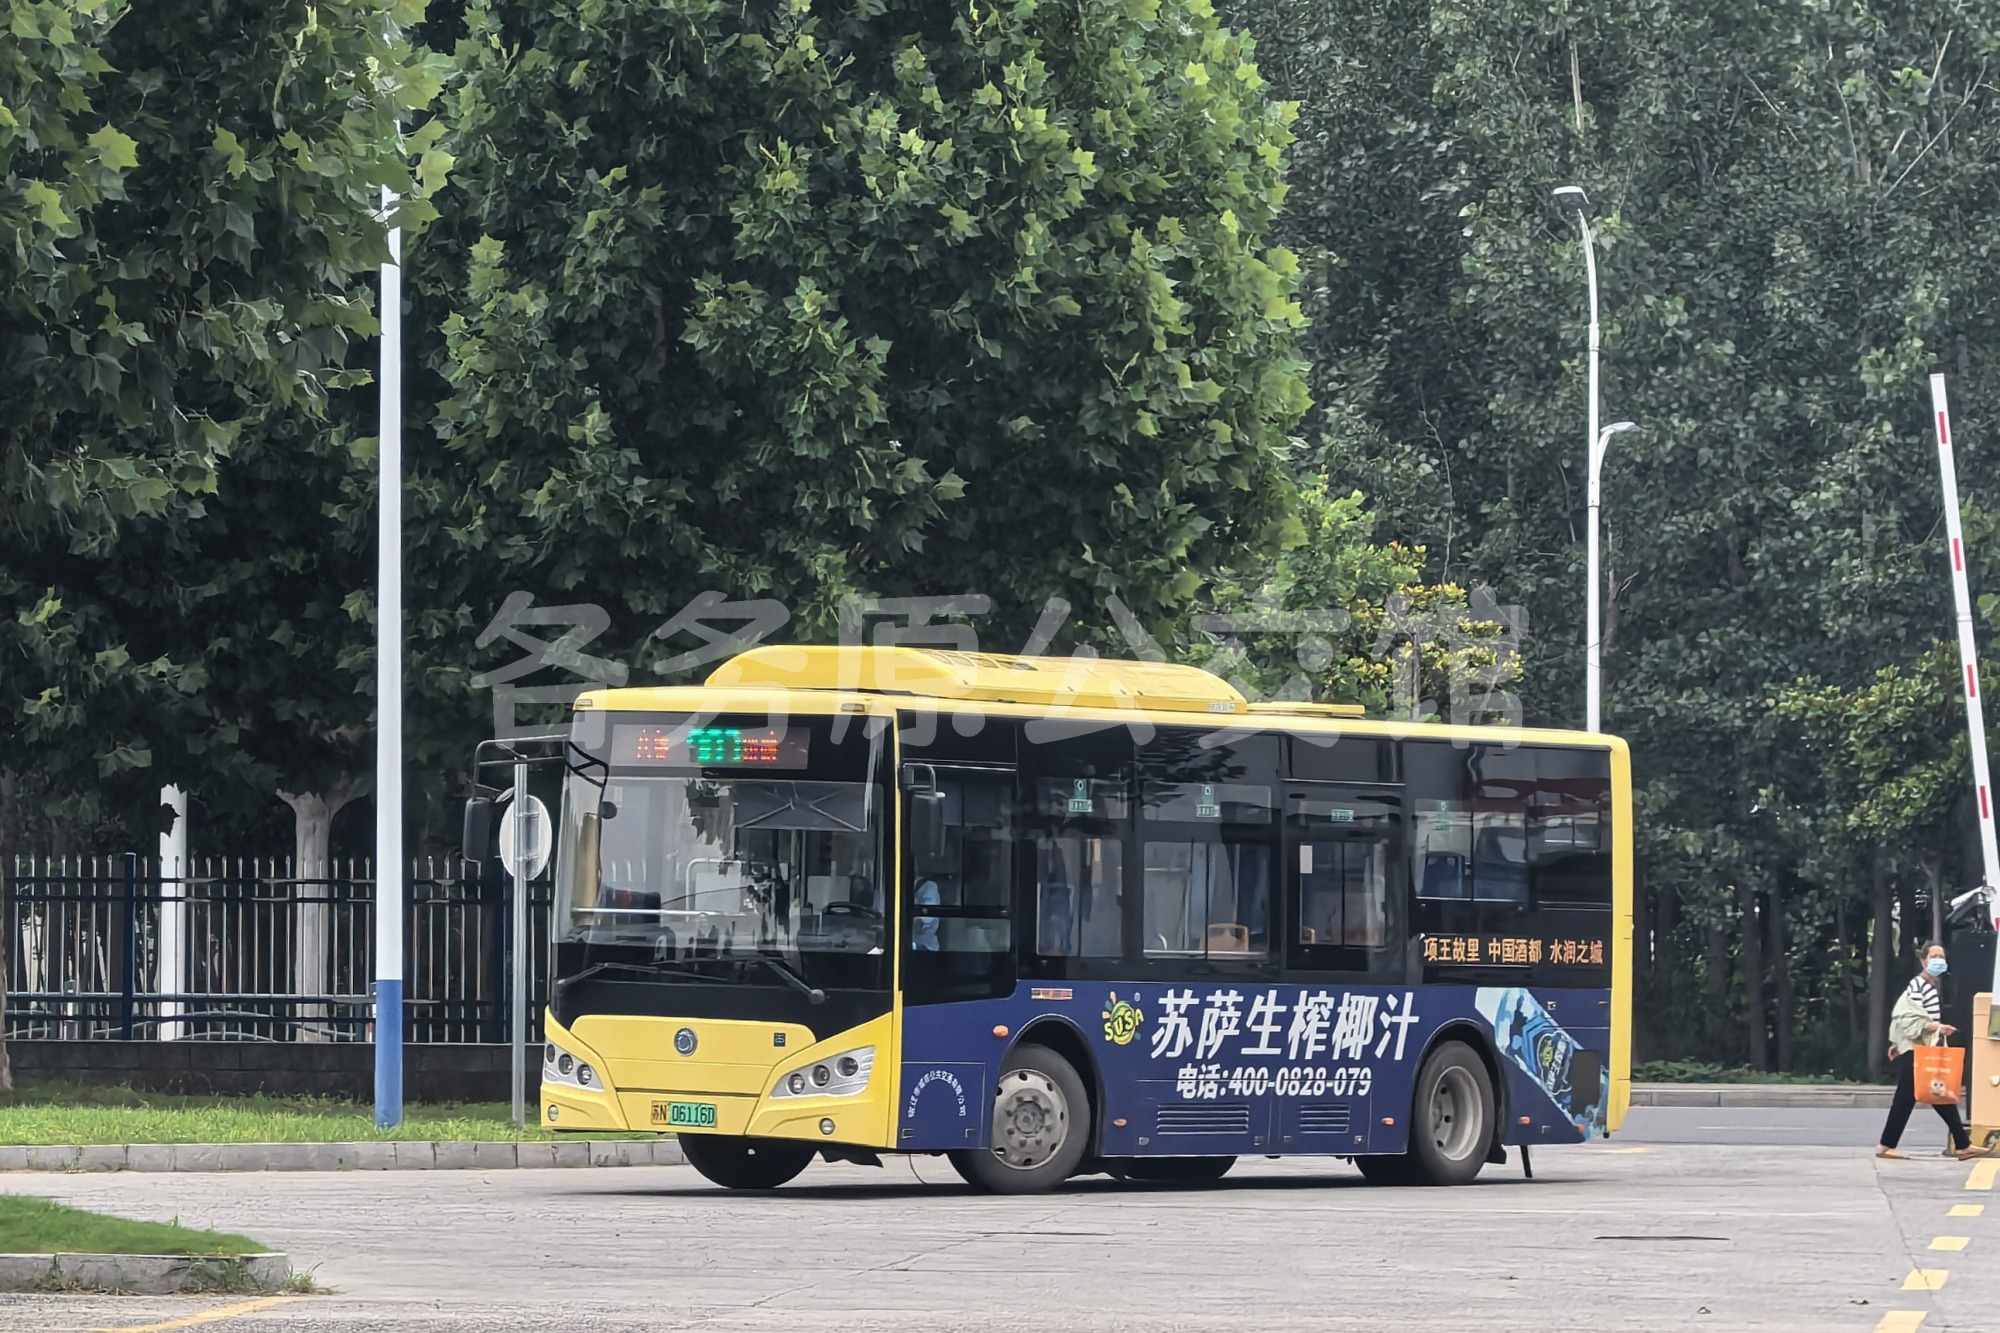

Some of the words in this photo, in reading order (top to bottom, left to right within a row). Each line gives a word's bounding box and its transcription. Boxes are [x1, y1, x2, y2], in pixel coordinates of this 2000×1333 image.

[1423, 937, 1480, 962] 项王故里
[1488, 937, 1542, 964] 中国酒都
[1549, 938, 1603, 965] 水润之城
[1104, 1008, 1145, 1042] SUSA
[1151, 989, 1420, 1062] 苏萨生榨椰汁
